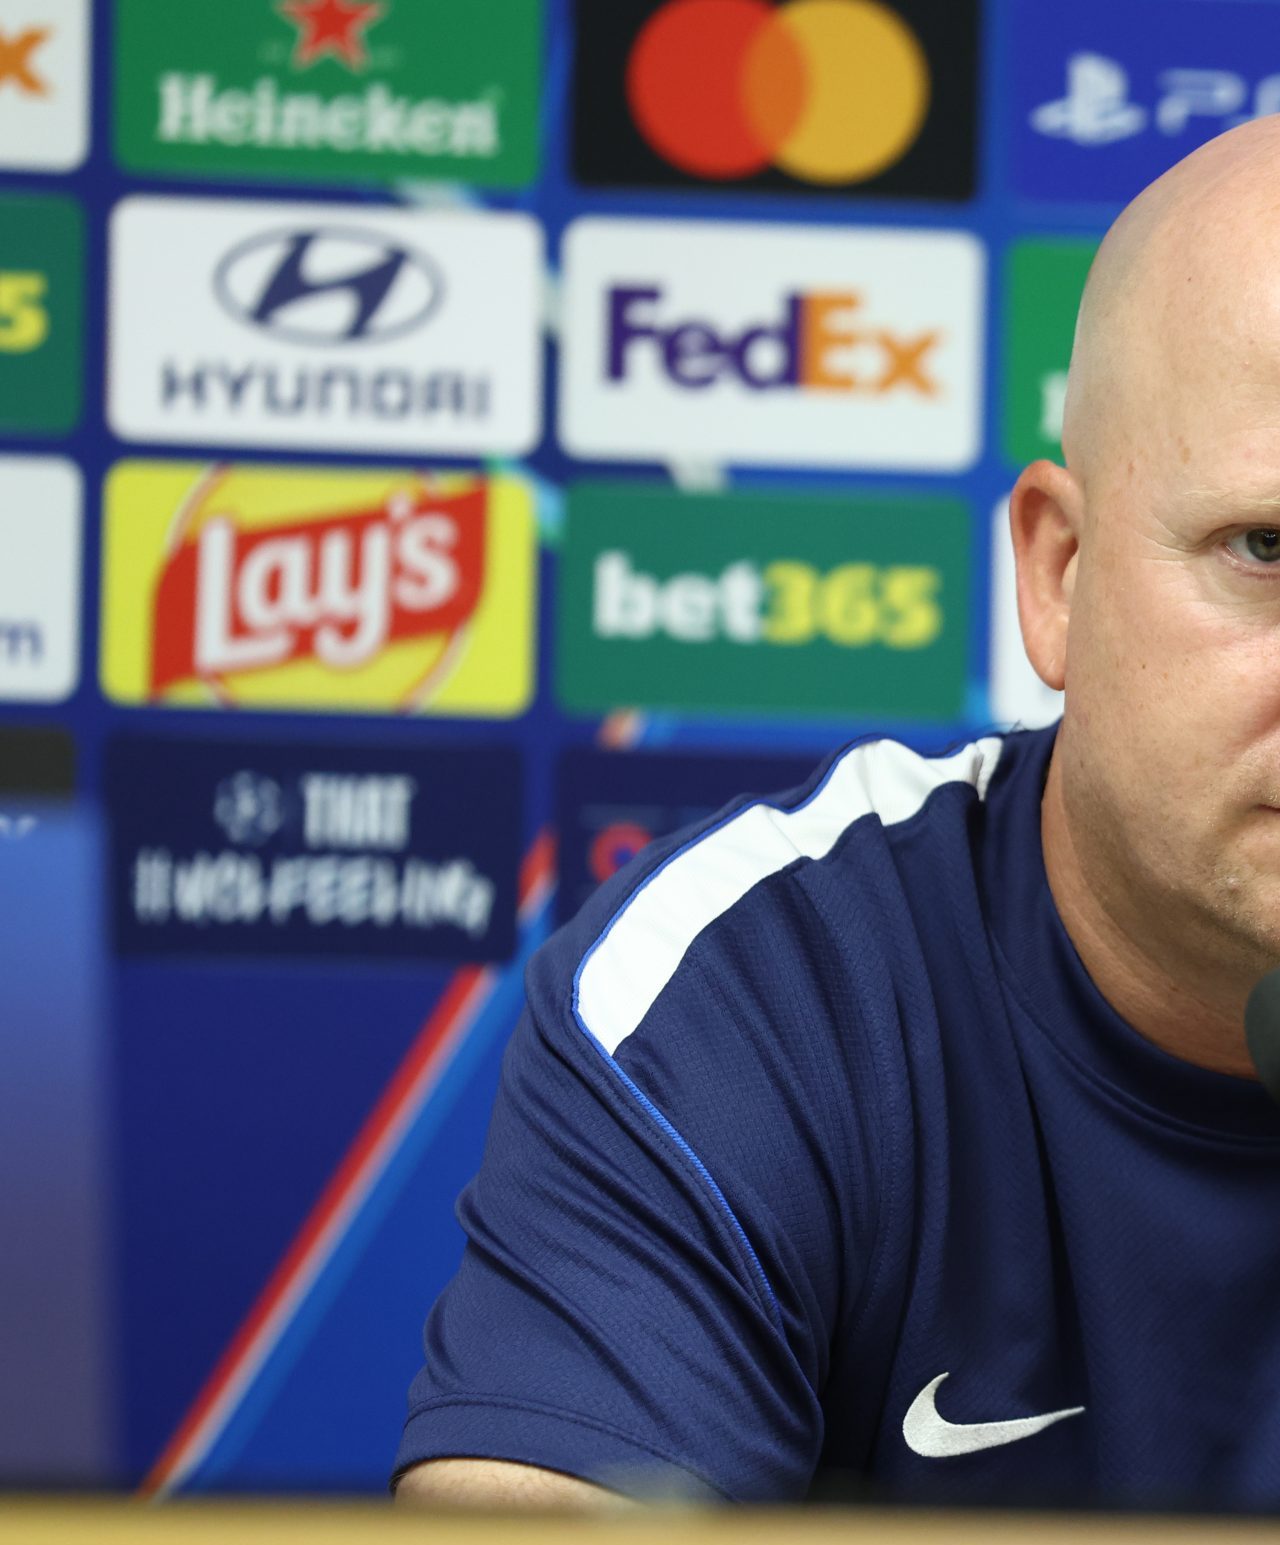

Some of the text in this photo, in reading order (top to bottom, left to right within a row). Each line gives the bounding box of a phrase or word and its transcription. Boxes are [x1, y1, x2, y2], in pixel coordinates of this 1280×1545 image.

[157, 72, 499, 158] Heineken
[161, 360, 490, 420] HYUNDAI
[606, 284, 942, 401] FedEx
[195, 490, 460, 667] Lay's
[594, 551, 942, 649] bet365
